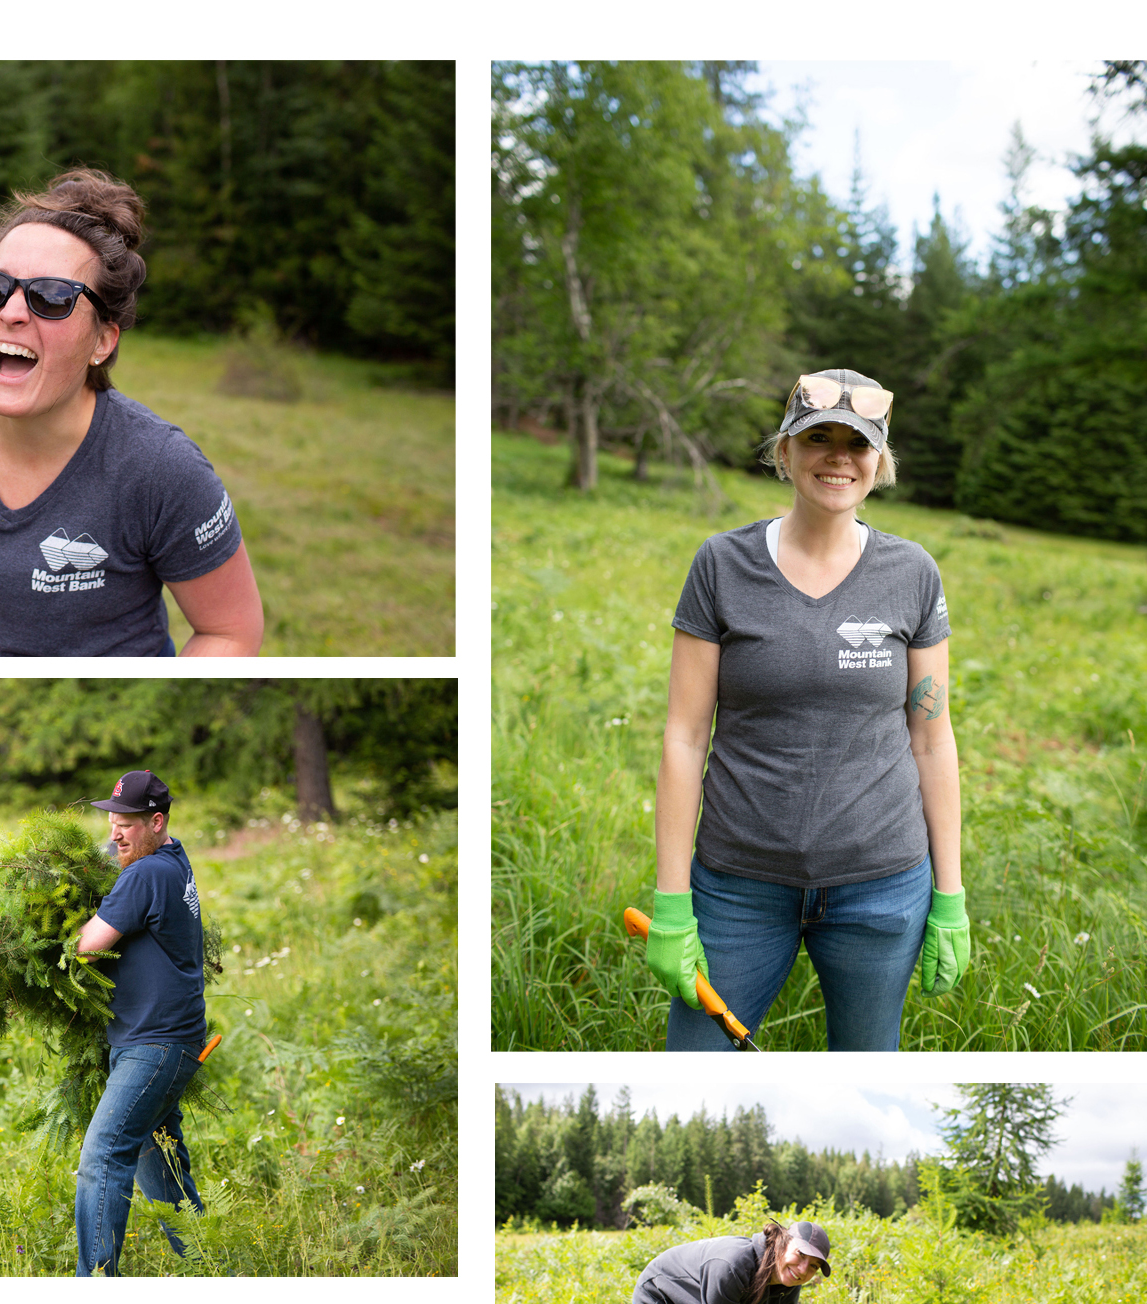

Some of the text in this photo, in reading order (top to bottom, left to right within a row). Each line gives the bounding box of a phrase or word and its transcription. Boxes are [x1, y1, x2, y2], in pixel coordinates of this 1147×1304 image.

[196, 519, 224, 545] West
[32, 568, 105, 583] Mountain
[31, 578, 105, 593] West Bank
[838, 649, 892, 659] Mountain
[838, 658, 893, 669] West Bank
